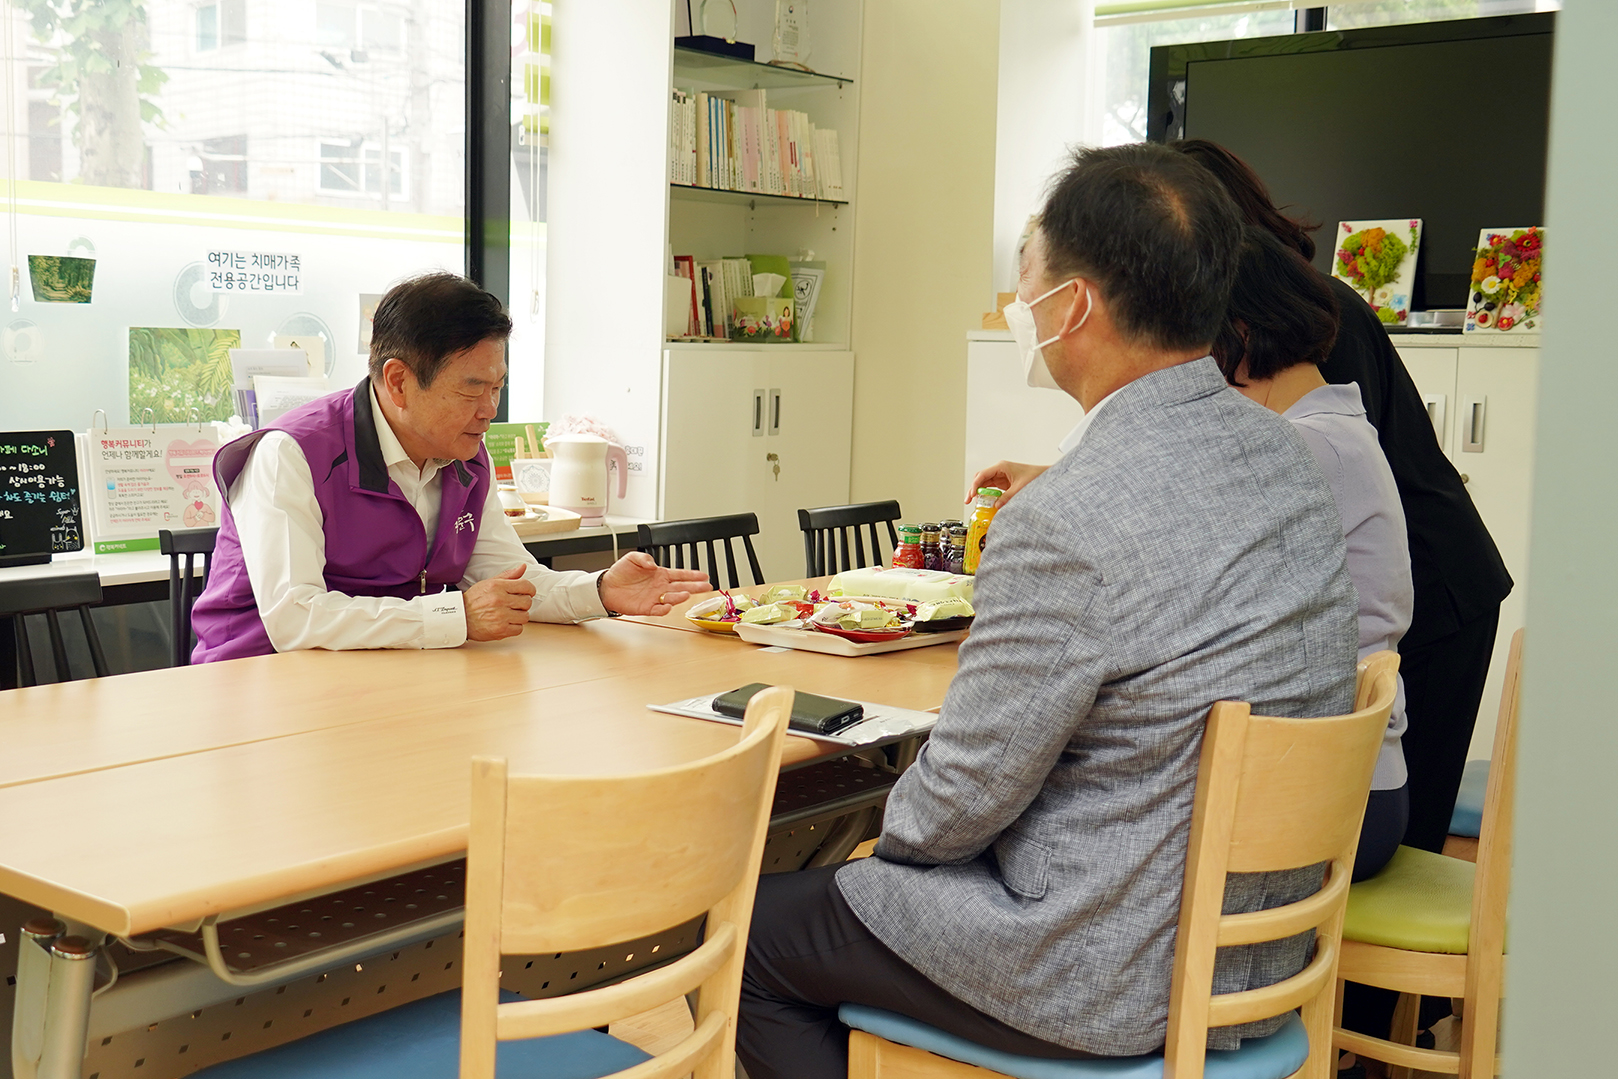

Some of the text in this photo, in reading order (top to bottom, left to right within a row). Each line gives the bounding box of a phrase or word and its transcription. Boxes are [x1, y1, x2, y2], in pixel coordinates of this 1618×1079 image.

[208, 252, 301, 272] 여기는 치매가족
[210, 271, 299, 290] 전용공간입니다
[100, 439, 152, 449] 행복커뮤니티가
[20, 445, 48, 456] 다소니
[101, 451, 123, 460] 언제나
[124, 450, 163, 460] 함께할게요!
